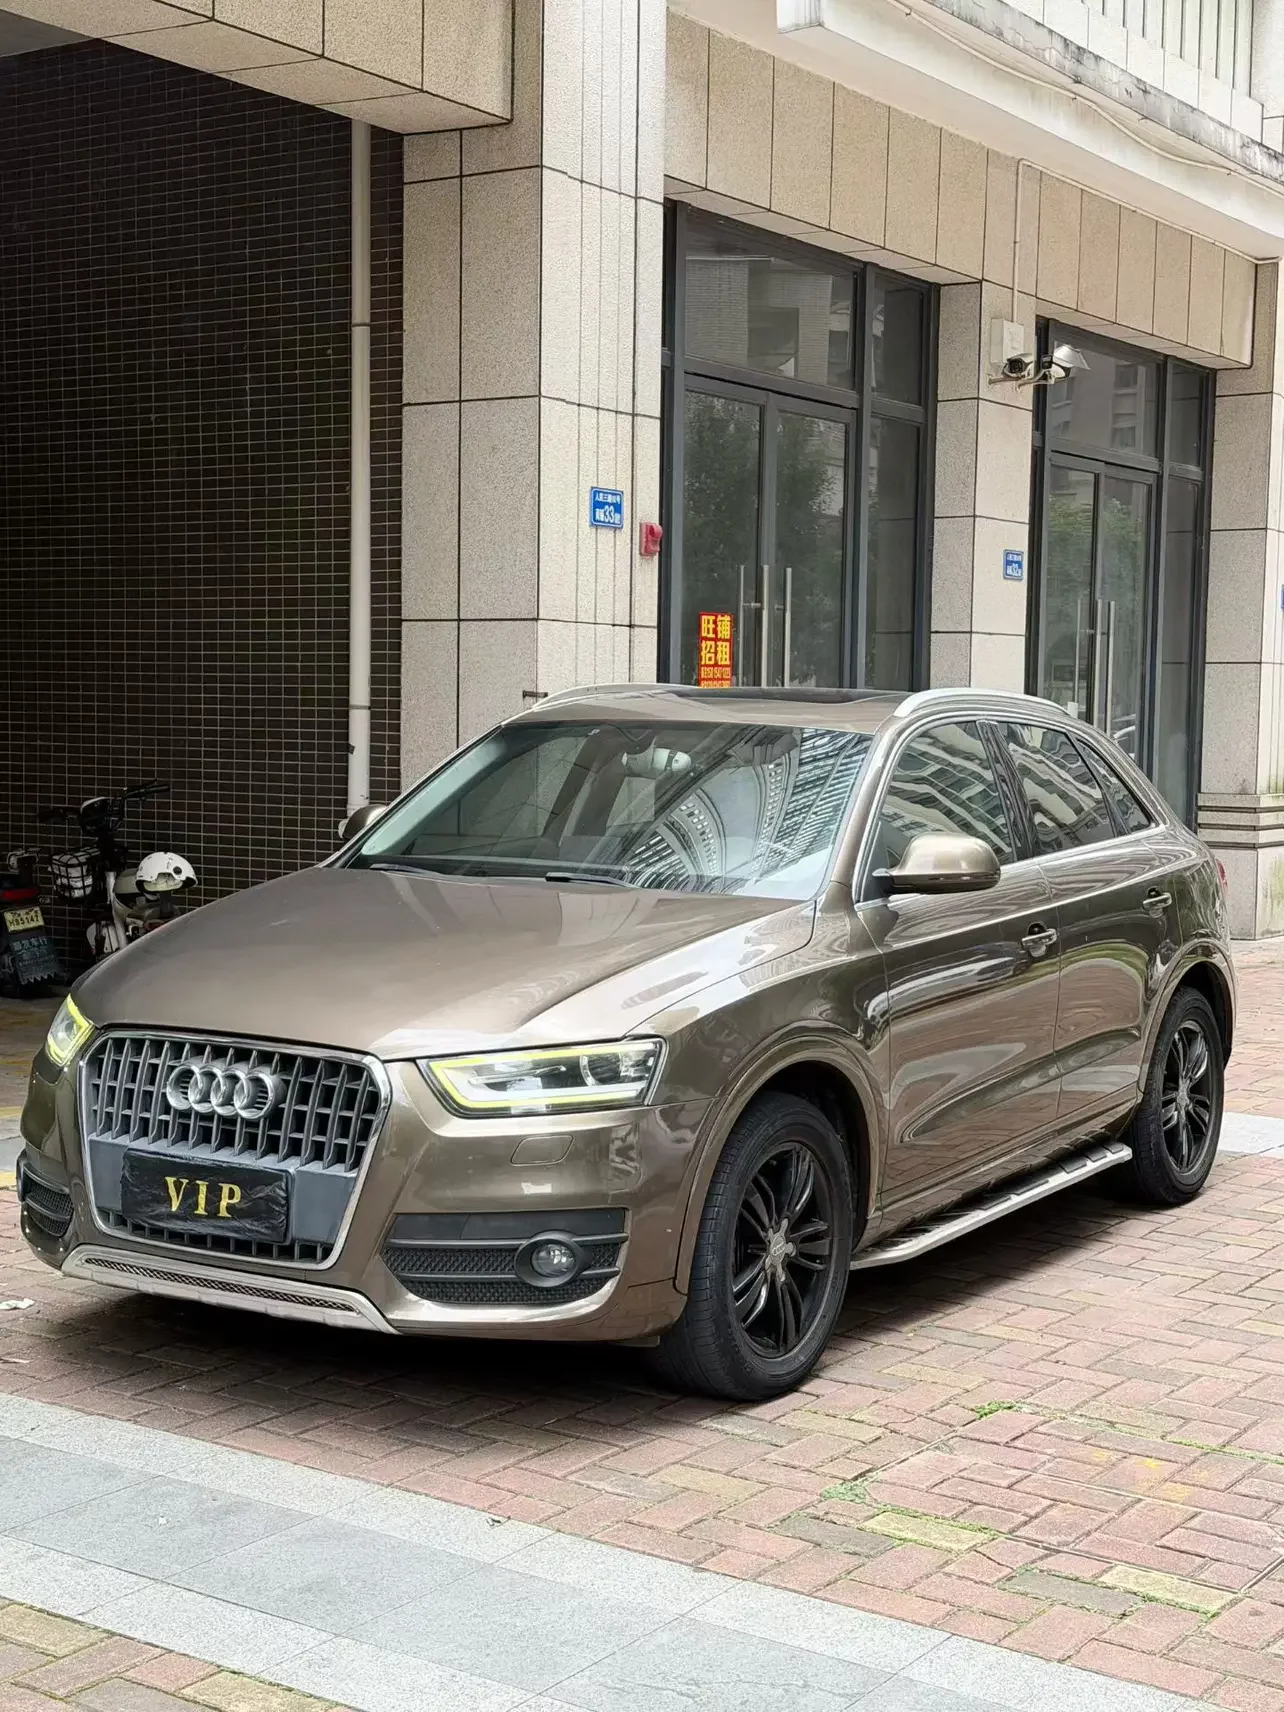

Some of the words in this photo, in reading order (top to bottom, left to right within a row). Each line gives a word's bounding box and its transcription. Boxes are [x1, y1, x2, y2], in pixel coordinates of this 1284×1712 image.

[701, 615, 731, 639] 旺铺
[701, 641, 730, 665] 招租
[165, 1176, 242, 1218] VIP
